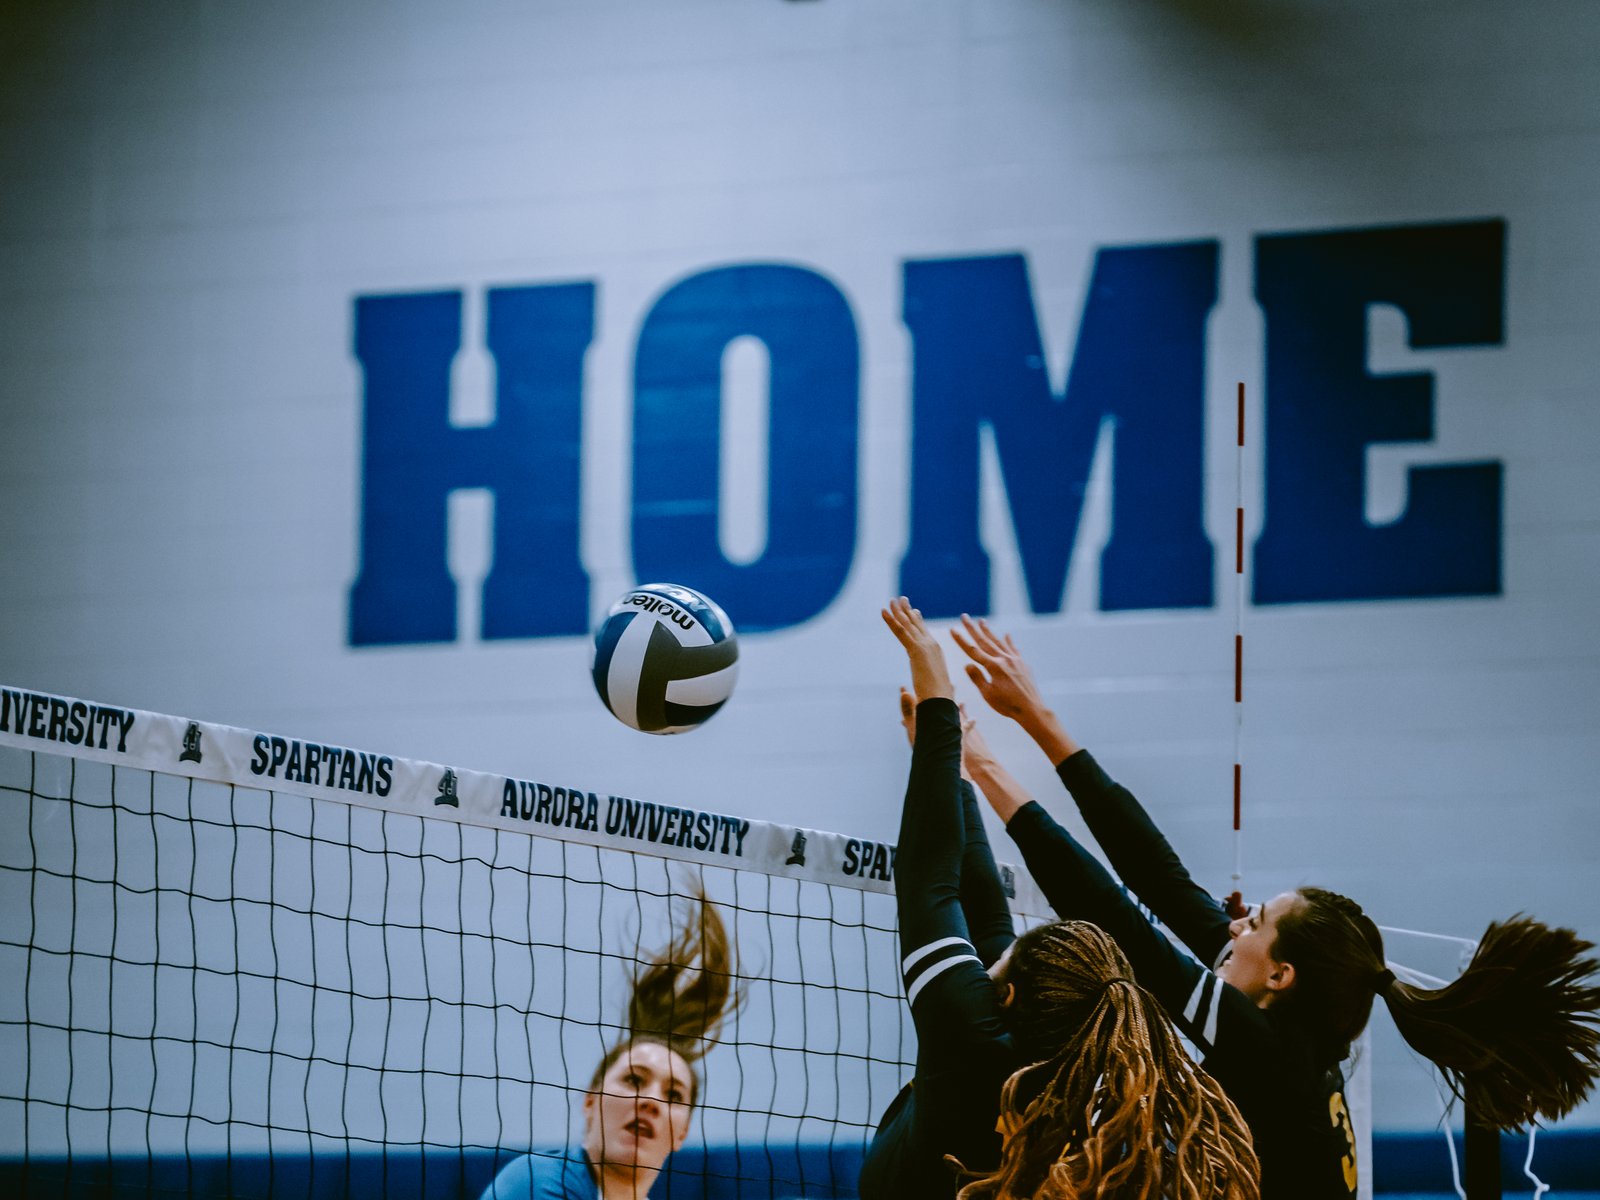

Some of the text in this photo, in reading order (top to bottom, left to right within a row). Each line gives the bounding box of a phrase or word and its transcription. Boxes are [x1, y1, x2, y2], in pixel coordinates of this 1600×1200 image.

[346, 219, 1506, 647] HOME
[250, 733, 393, 797] SPARTANS
[500, 778, 598, 832] AURORA
[605, 795, 749, 857] UNIVERSITY
